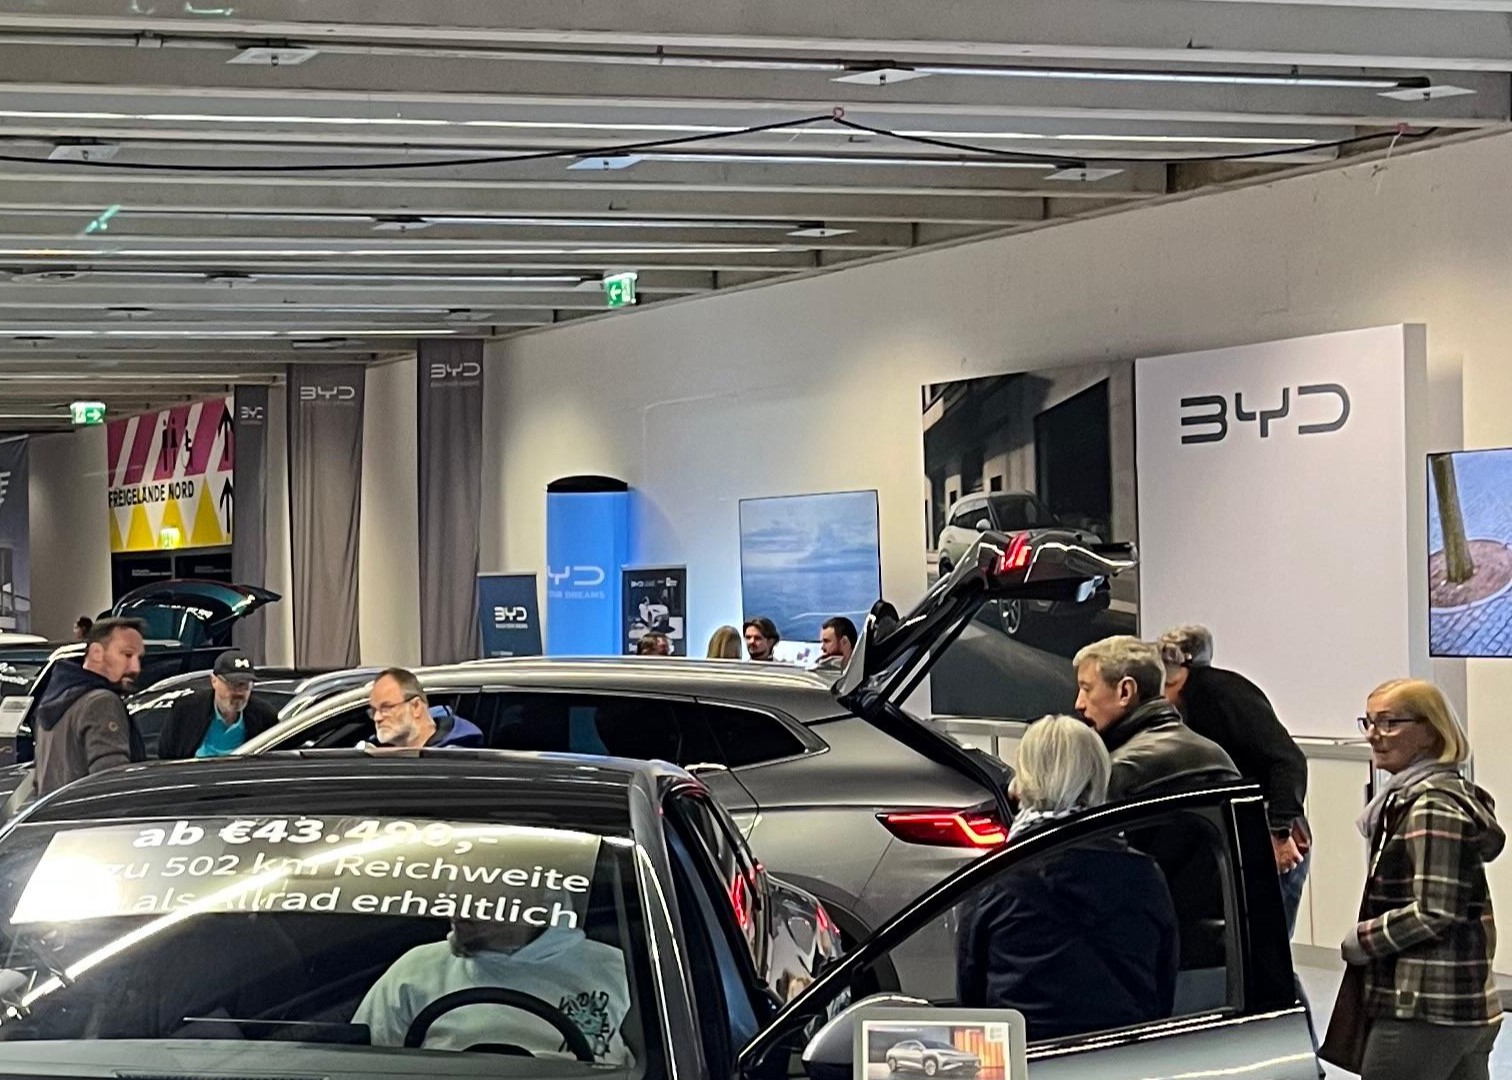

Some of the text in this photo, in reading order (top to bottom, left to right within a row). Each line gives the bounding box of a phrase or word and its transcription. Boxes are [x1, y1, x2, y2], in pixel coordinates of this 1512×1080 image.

[430, 362, 481, 378] BYD
[300, 386, 356, 400] BYD
[1180, 382, 1351, 445] BYD
[168, 480, 195, 499] NORD
[547, 565, 605, 586] YD
[494, 606, 528, 622] BYD
[133, 820, 205, 848] ab
[105, 851, 590, 893] zu 502 km Reichweite
[132, 887, 197, 913] als
[351, 889, 578, 930] erhältlich
